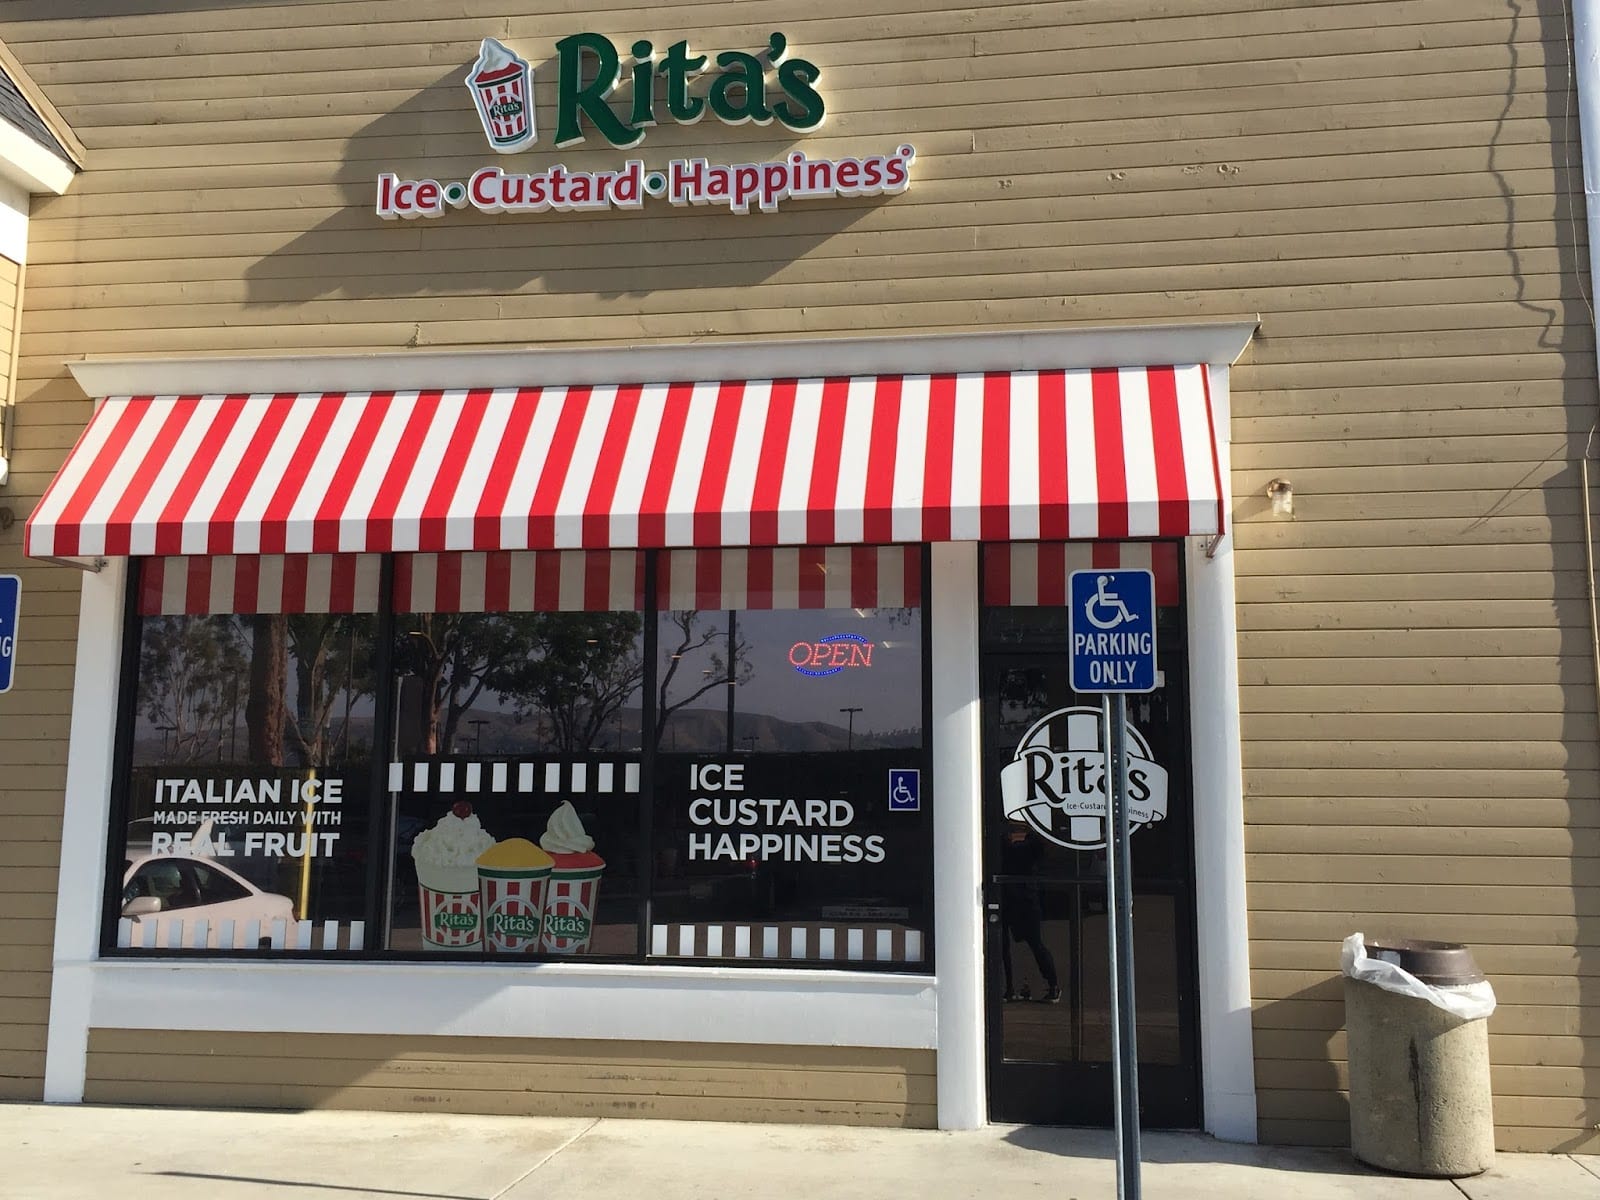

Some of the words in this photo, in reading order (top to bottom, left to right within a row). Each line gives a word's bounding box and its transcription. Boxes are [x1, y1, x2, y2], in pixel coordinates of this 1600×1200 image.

[554, 32, 827, 151] Rita's
[493, 102, 520, 116] Rita's
[381, 177, 438, 209] Ice
[470, 165, 638, 204] Custard
[673, 151, 905, 204] Happiness
[788, 642, 875, 667] OPEN
[1074, 632, 1152, 656] PARKING
[1089, 660, 1137, 684] ONLY
[690, 764, 745, 791] ICE
[154, 779, 282, 804] ITALIAN
[290, 779, 343, 804] ICE
[153, 811, 197, 825] MADE
[201, 811, 249, 825] FRESH
[253, 811, 296, 825] DAILY
[300, 811, 342, 825] WITH
[688, 798, 855, 826] CUSTARD
[151, 832, 236, 857] REAL
[244, 832, 341, 857] FRUIT
[688, 833, 886, 864] HAPPINESS
[440, 912, 474, 928] Rita's
[493, 913, 534, 933] Rita's
[543, 914, 585, 934] Rita's
